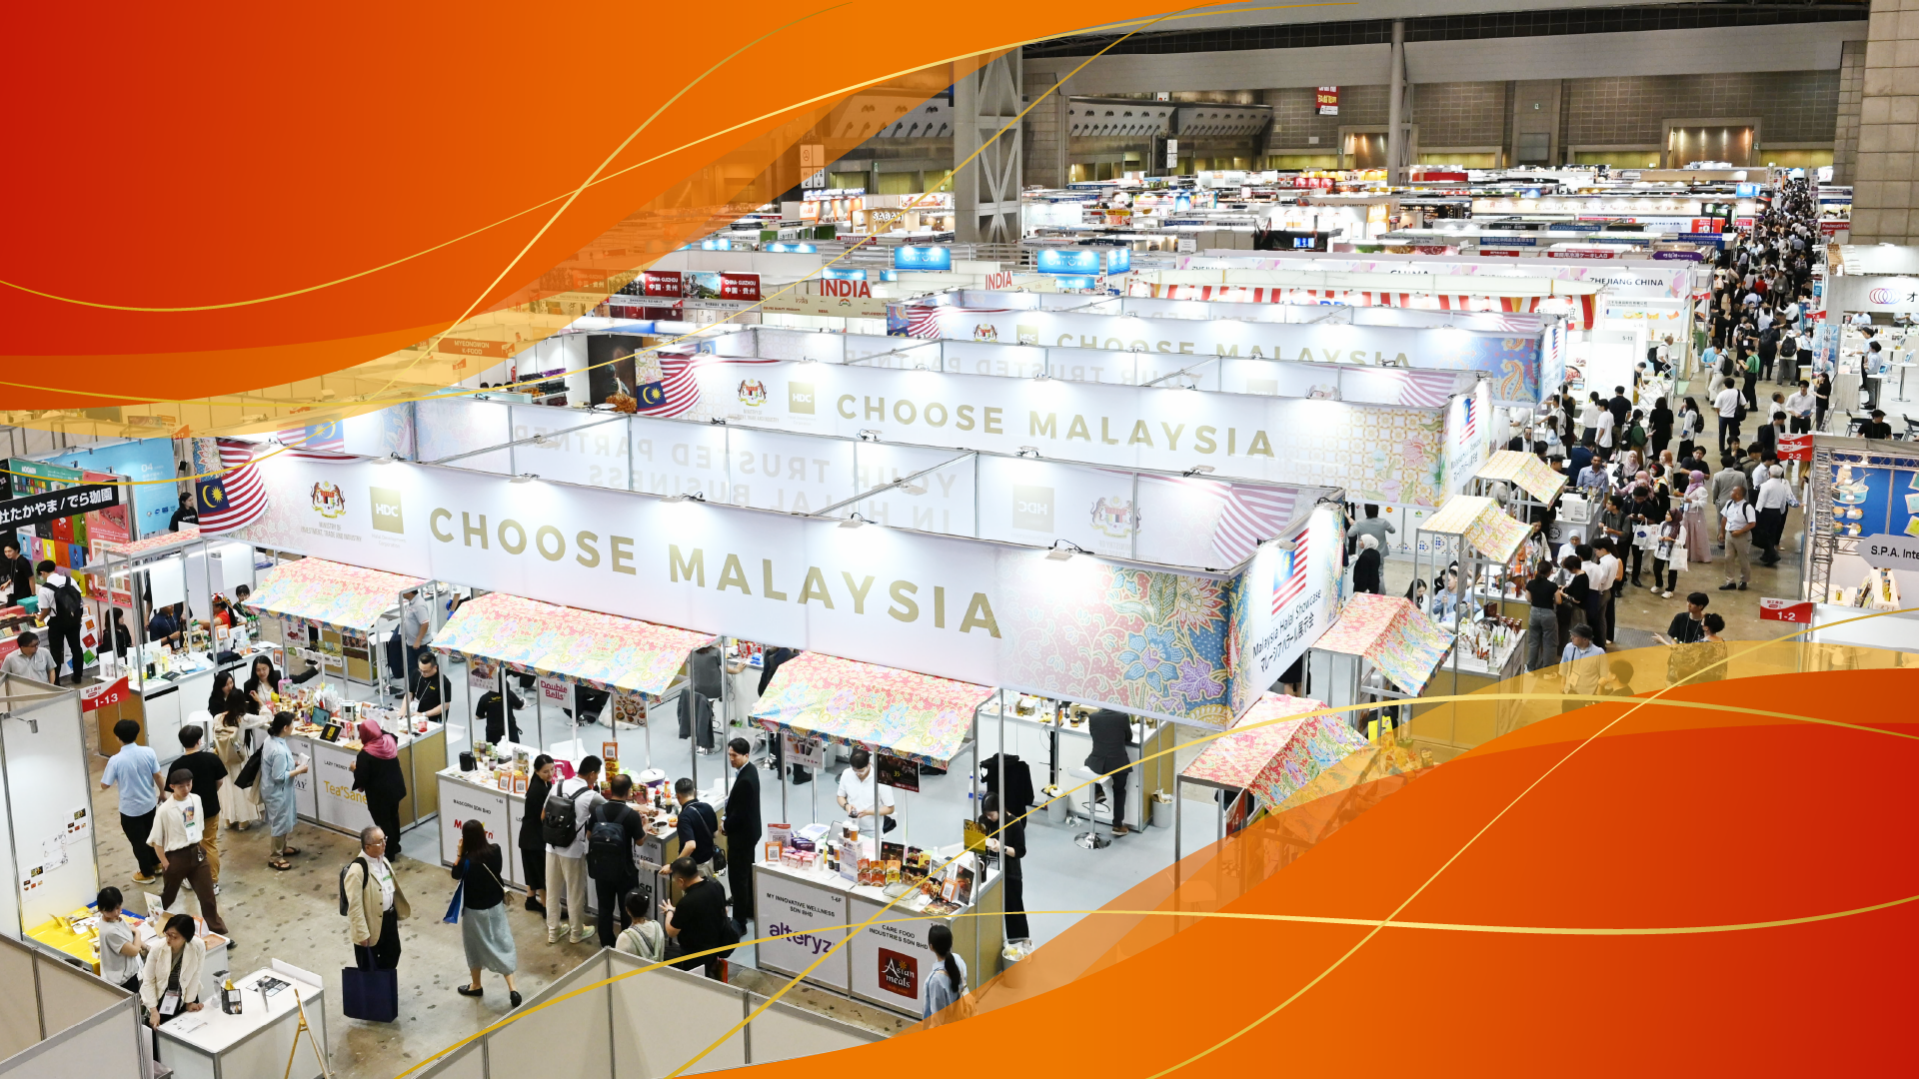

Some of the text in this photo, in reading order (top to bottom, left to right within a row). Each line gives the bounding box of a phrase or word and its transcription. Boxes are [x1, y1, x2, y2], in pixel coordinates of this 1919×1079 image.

[820, 279, 872, 298] INDIA
[985, 271, 1013, 291] INDIA
[1634, 277, 1664, 287] CHINA
[461, 347, 483, 355] K-FOOD
[1057, 333, 1410, 368] CHOOSE MALAYSIA
[792, 393, 812, 403] HDC
[837, 394, 1275, 458] CHOOSE MALAYSIA
[375, 503, 399, 517] HDC
[1871, 545, 1900, 559] S.P.A.
[430, 507, 1003, 639] CHOOSE MALAYSIA
[1253, 588, 1322, 659] Malaysia Halal Showcase
[1777, 611, 1796, 621] 1-2
[540, 680, 568, 695] Double
[545, 689, 564, 701] Bells
[94, 692, 119, 708] 1-13
[775, 895, 806, 909] INNOVATIVE
[806, 904, 835, 917] WELLNESS
[790, 906, 813, 918] SDN BHD
[769, 921, 832, 955] alteryz
[869, 927, 929, 950] INDUSTRIES SDN BHD
[881, 924, 915, 939] CARE FOOD
[881, 957, 915, 979] Asian
[885, 974, 911, 988] meals
